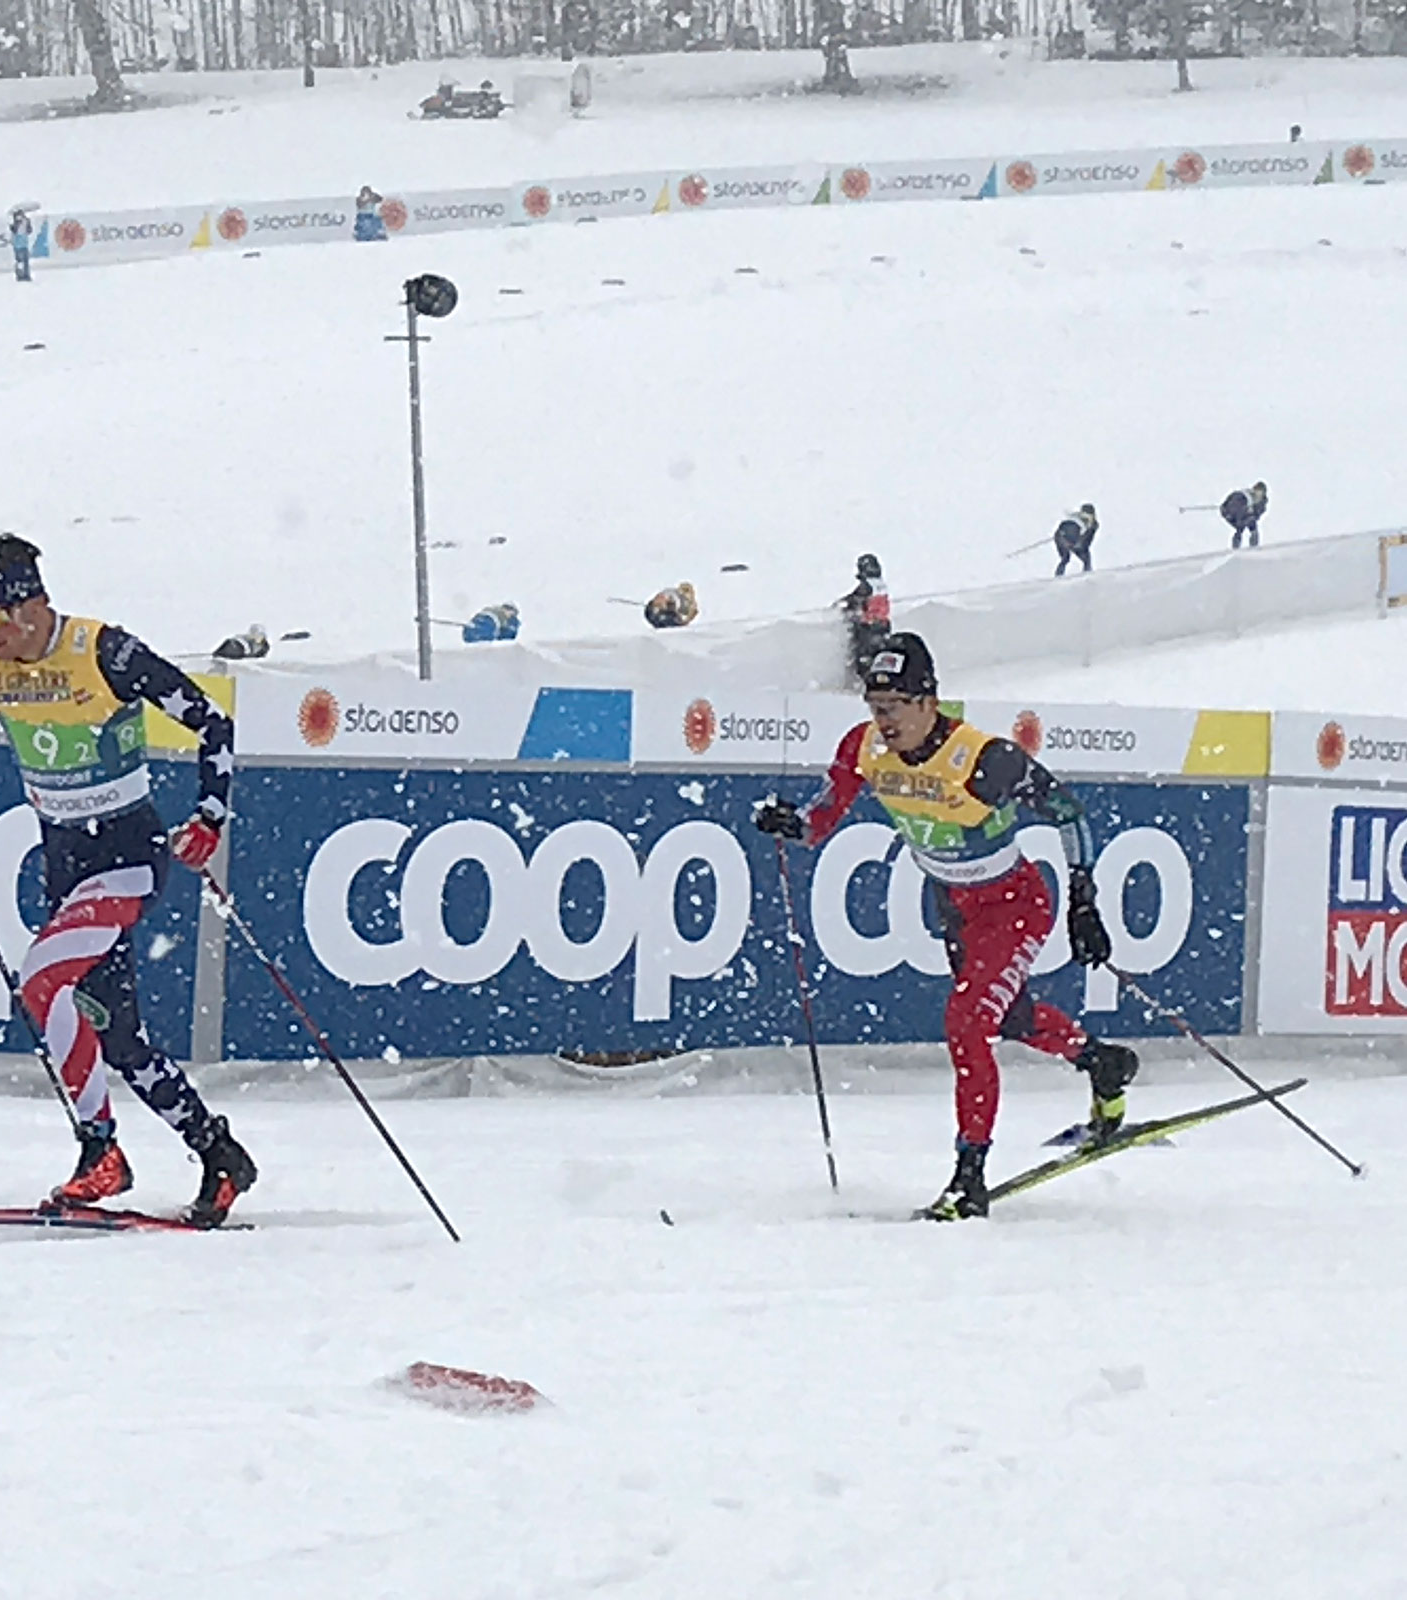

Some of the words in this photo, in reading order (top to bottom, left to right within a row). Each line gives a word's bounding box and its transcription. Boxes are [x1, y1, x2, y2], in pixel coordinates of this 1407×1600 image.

[32, 728, 59, 767] 9
[74, 742, 92, 762] 2
[120, 725, 135, 745] 9
[303, 818, 751, 1022] coop
[980, 935, 1041, 1025] JAPAN
